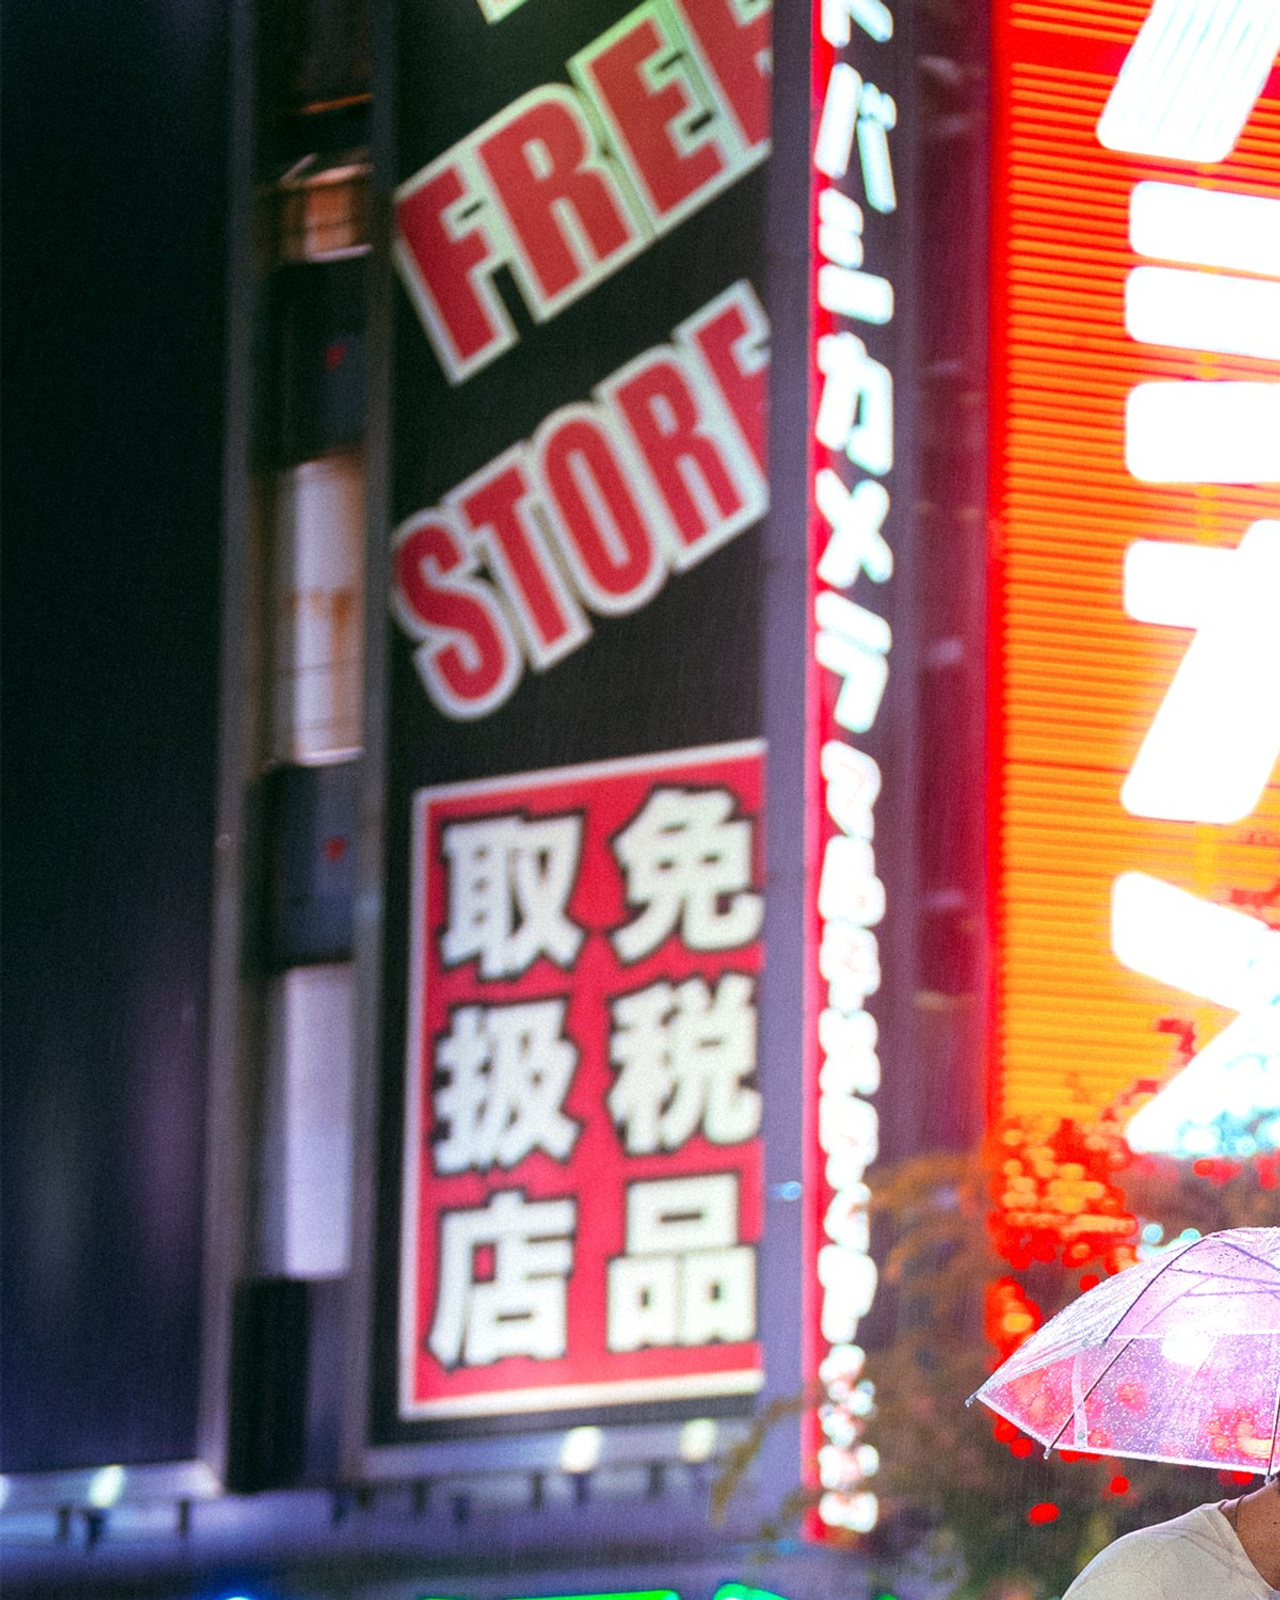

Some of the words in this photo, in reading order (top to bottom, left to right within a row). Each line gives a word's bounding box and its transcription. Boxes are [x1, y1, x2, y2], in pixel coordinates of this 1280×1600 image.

[427, 808, 587, 1371] 取扱店
[607, 787, 766, 1353] 免税品
